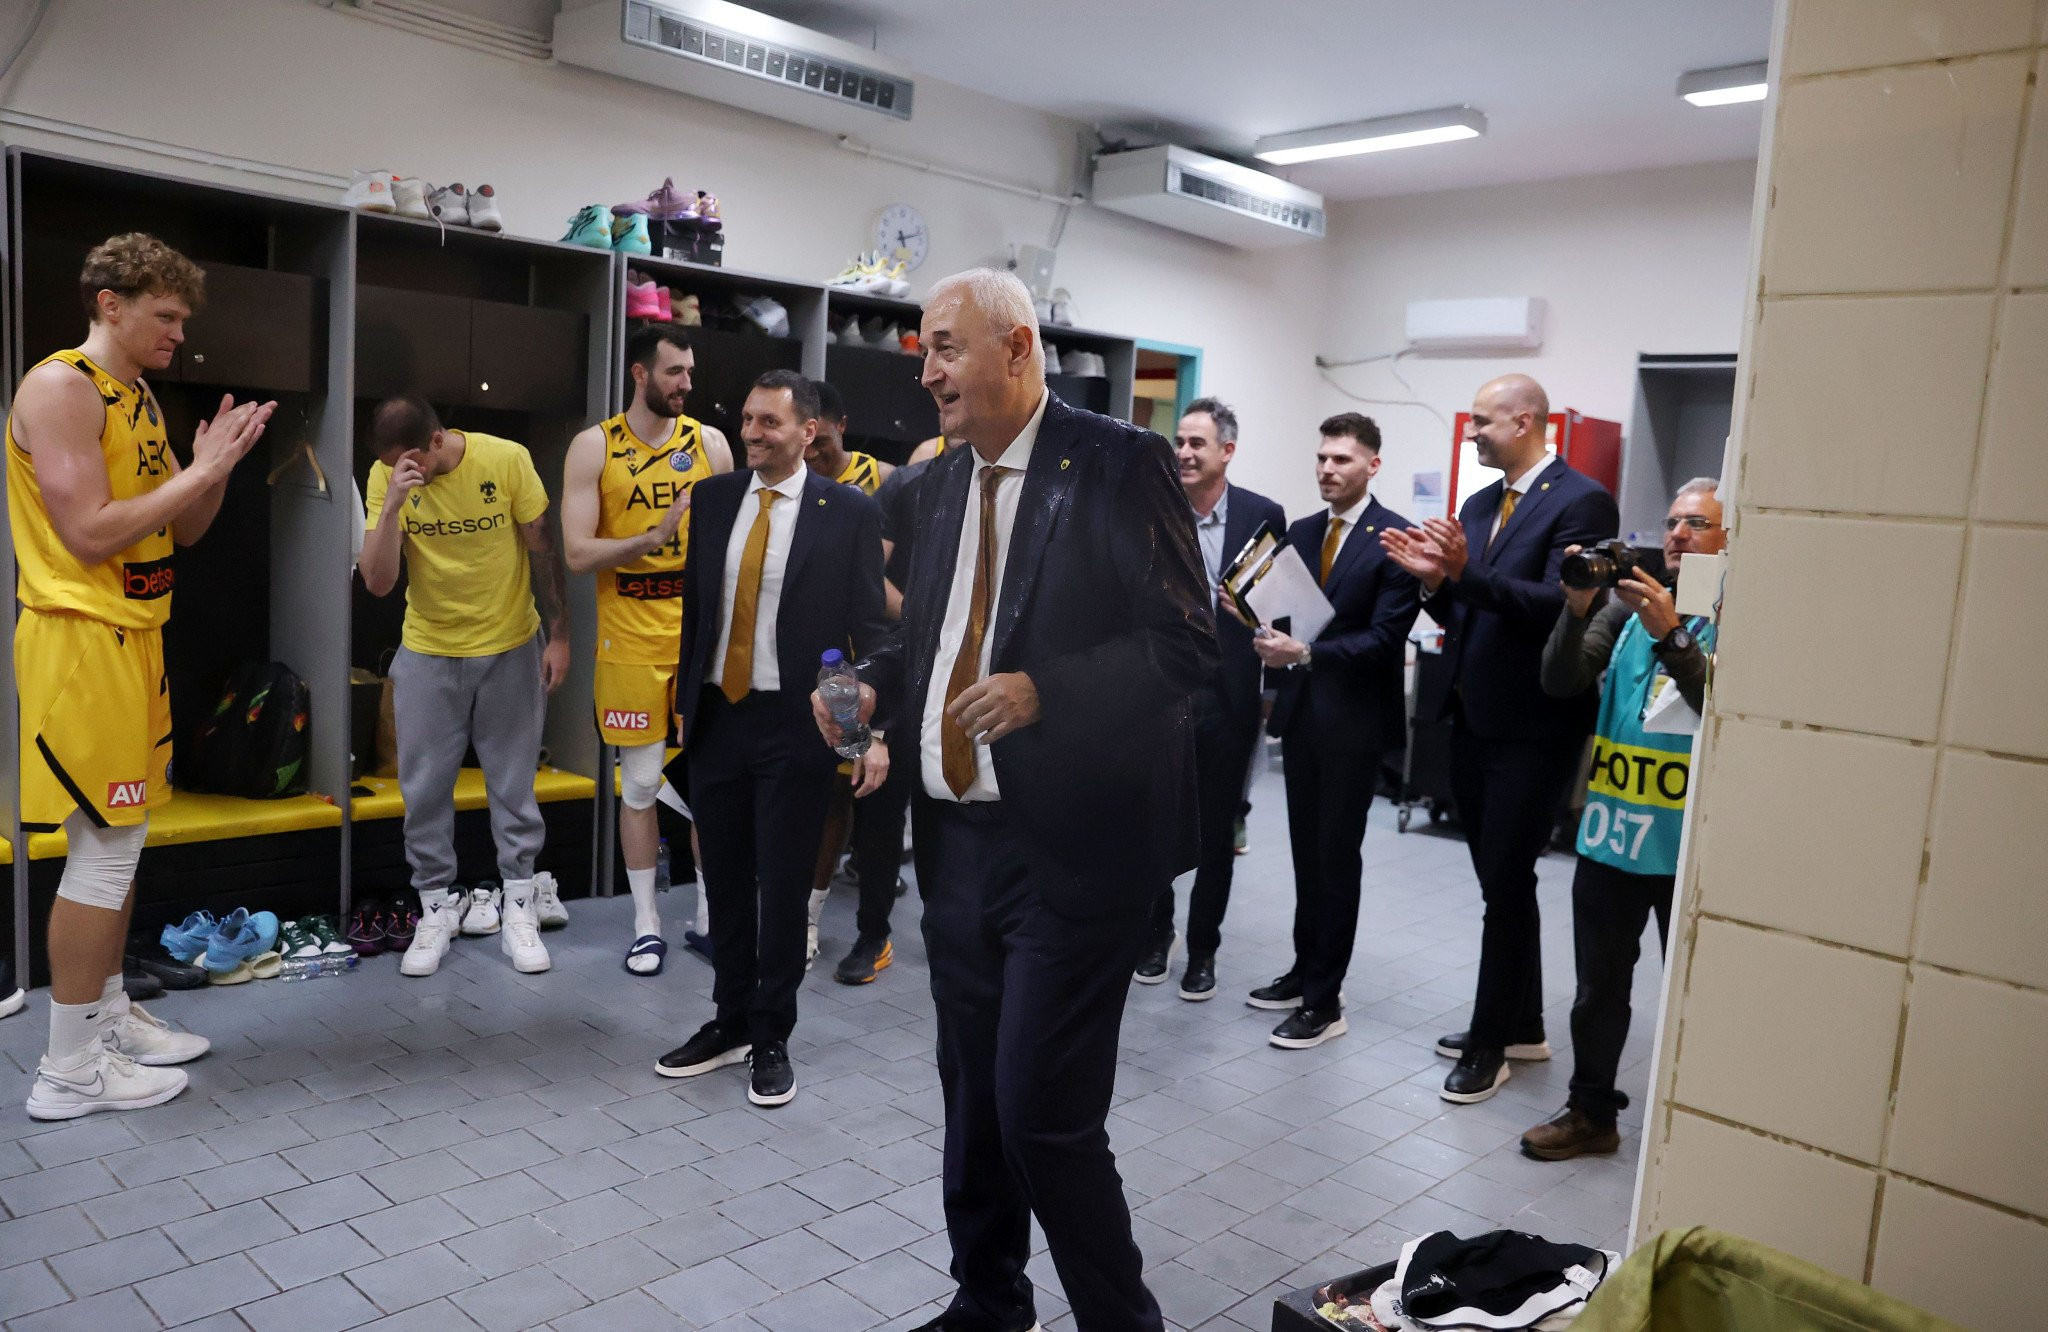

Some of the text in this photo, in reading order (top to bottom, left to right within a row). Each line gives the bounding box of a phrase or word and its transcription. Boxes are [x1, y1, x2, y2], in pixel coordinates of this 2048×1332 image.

[136, 440, 169, 476] AEK
[626, 481, 693, 510] AEK
[406, 513, 504, 536] betsson
[605, 711, 648, 729] AVIS
[1583, 801, 1655, 860] 057
